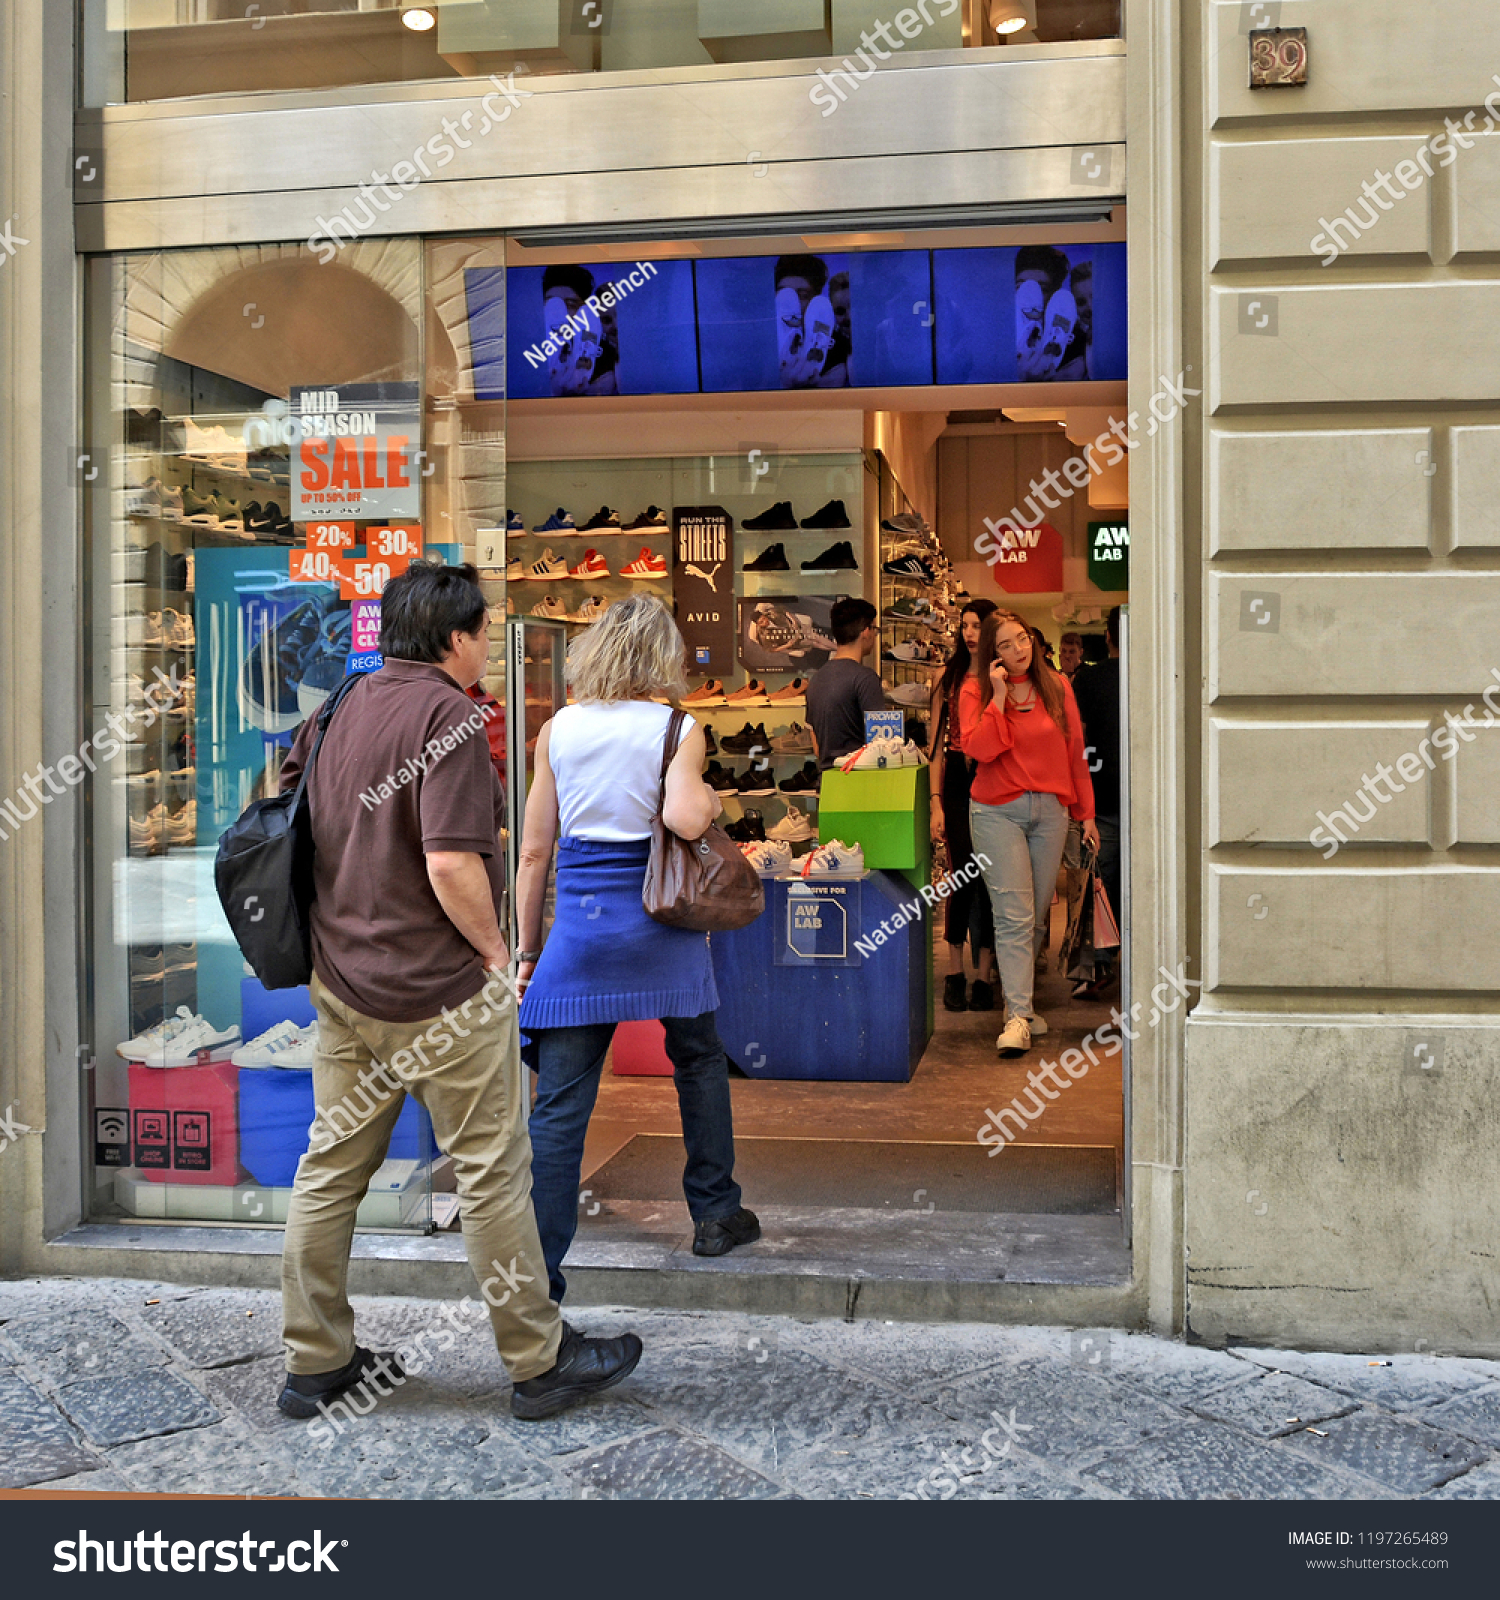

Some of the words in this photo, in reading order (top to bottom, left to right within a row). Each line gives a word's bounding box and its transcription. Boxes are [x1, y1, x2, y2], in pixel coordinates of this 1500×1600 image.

[1252, 38, 1306, 80] 39
[300, 391, 339, 413] MID
[301, 413, 376, 437] SEASON
[300, 435, 410, 491] SALE
[301, 493, 312, 503] UP
[314, 493, 325, 503] TO
[326, 492, 345, 503] 50%
[346, 491, 361, 502] OFF
[310, 525, 352, 547] -20%
[371, 530, 418, 556] -30%
[680, 524, 726, 562] STREETS
[1001, 529, 1042, 549] AW
[292, 552, 340, 577] -40%
[1000, 551, 1028, 564] LAB
[1094, 548, 1123, 562] LAB
[687, 612, 720, 622] AVID
[866, 712, 901, 722] PROMO
[795, 905, 819, 916] AW
[795, 917, 823, 929] LAB
